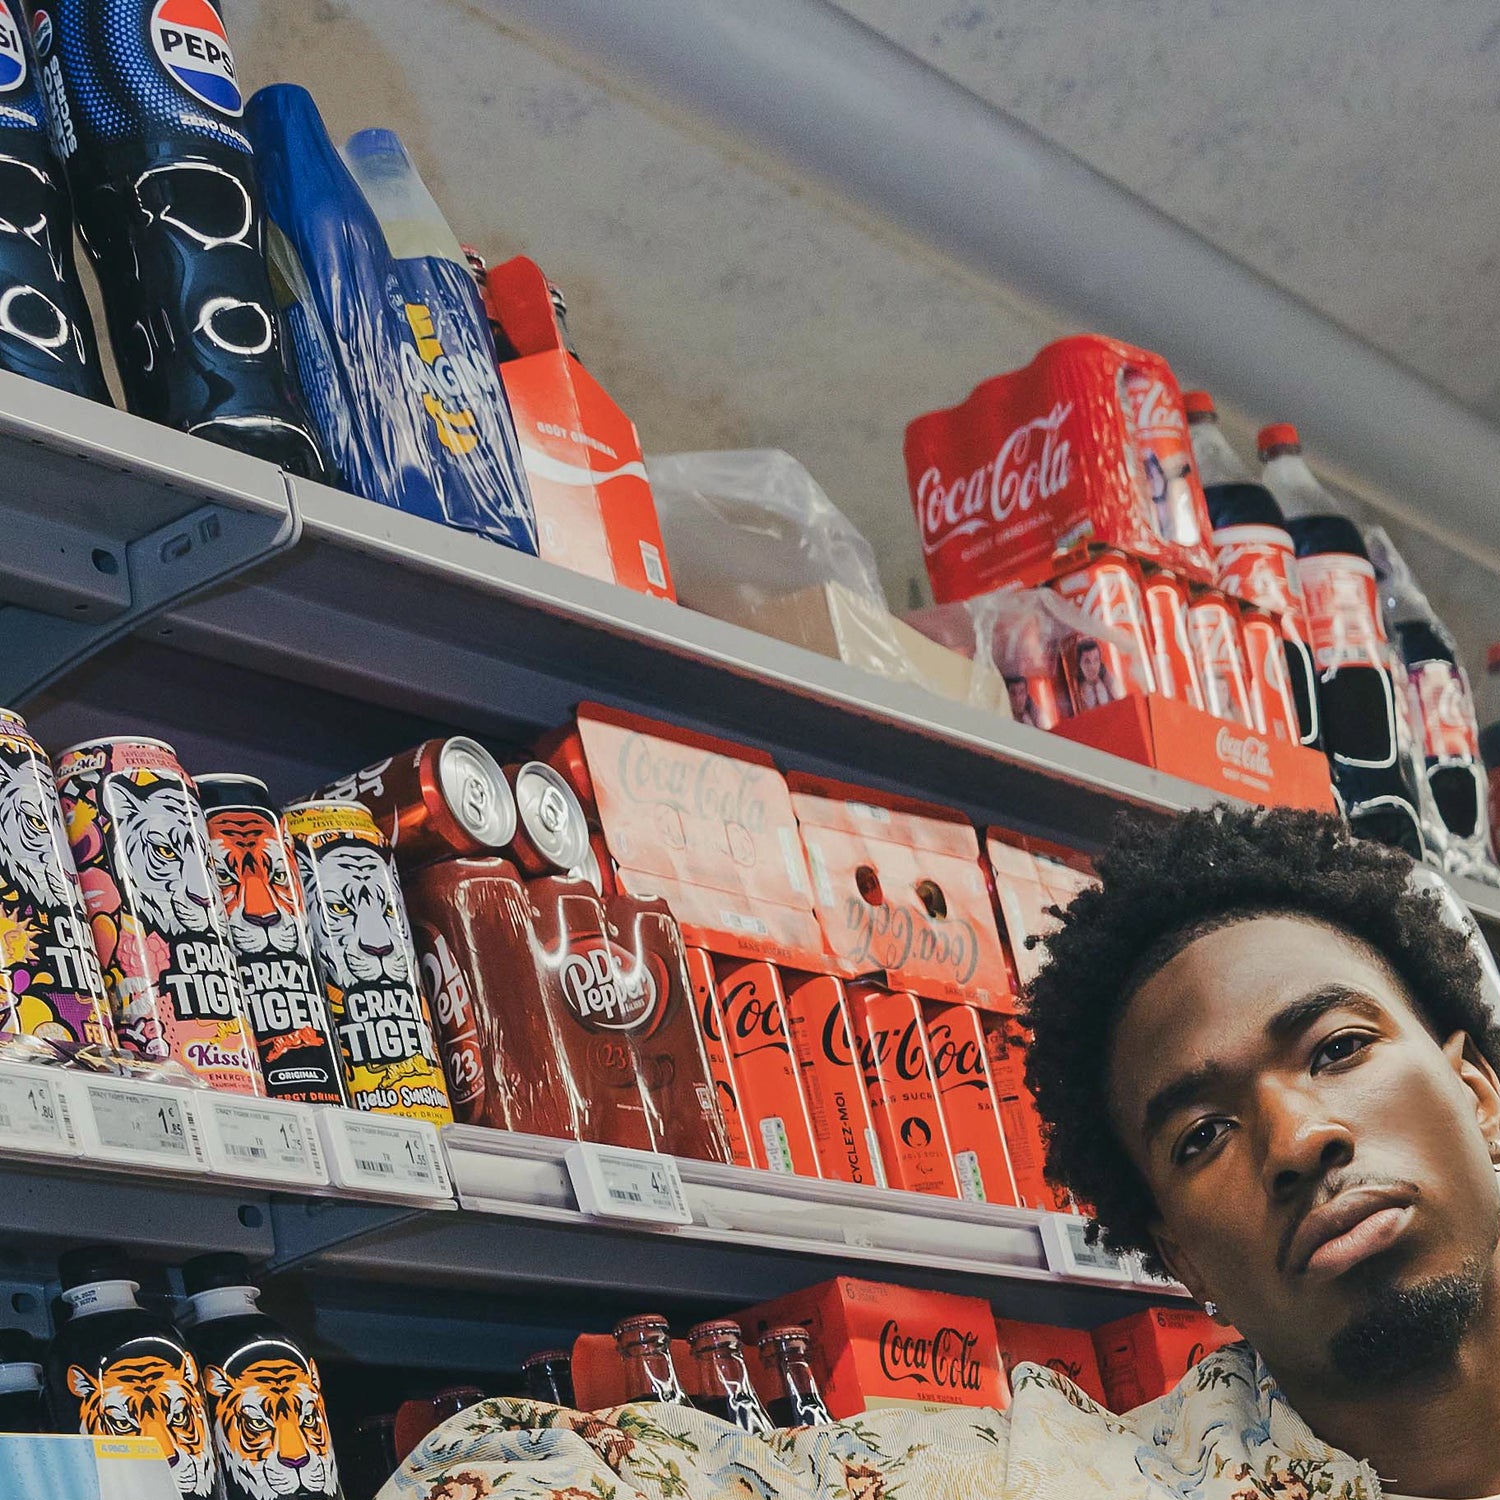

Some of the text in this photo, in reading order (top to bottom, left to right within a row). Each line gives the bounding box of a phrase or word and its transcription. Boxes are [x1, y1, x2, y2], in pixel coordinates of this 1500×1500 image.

[160, 28, 239, 84] PEPS
[916, 401, 1074, 556] Coca-Cola
[239, 960, 310, 995] CRAZY
[244, 991, 329, 1033] TIGER
[350, 988, 420, 1021] CRAZY
[188, 1042, 240, 1067] Kiss
[340, 1019, 438, 1063] TIGER
[278, 1070, 319, 1081] ORIGINAL
[451, 1048, 478, 1083] 23
[834, 1091, 863, 1185] CYCLEZ-MOI
[879, 1319, 982, 1391] Coca-Cola
